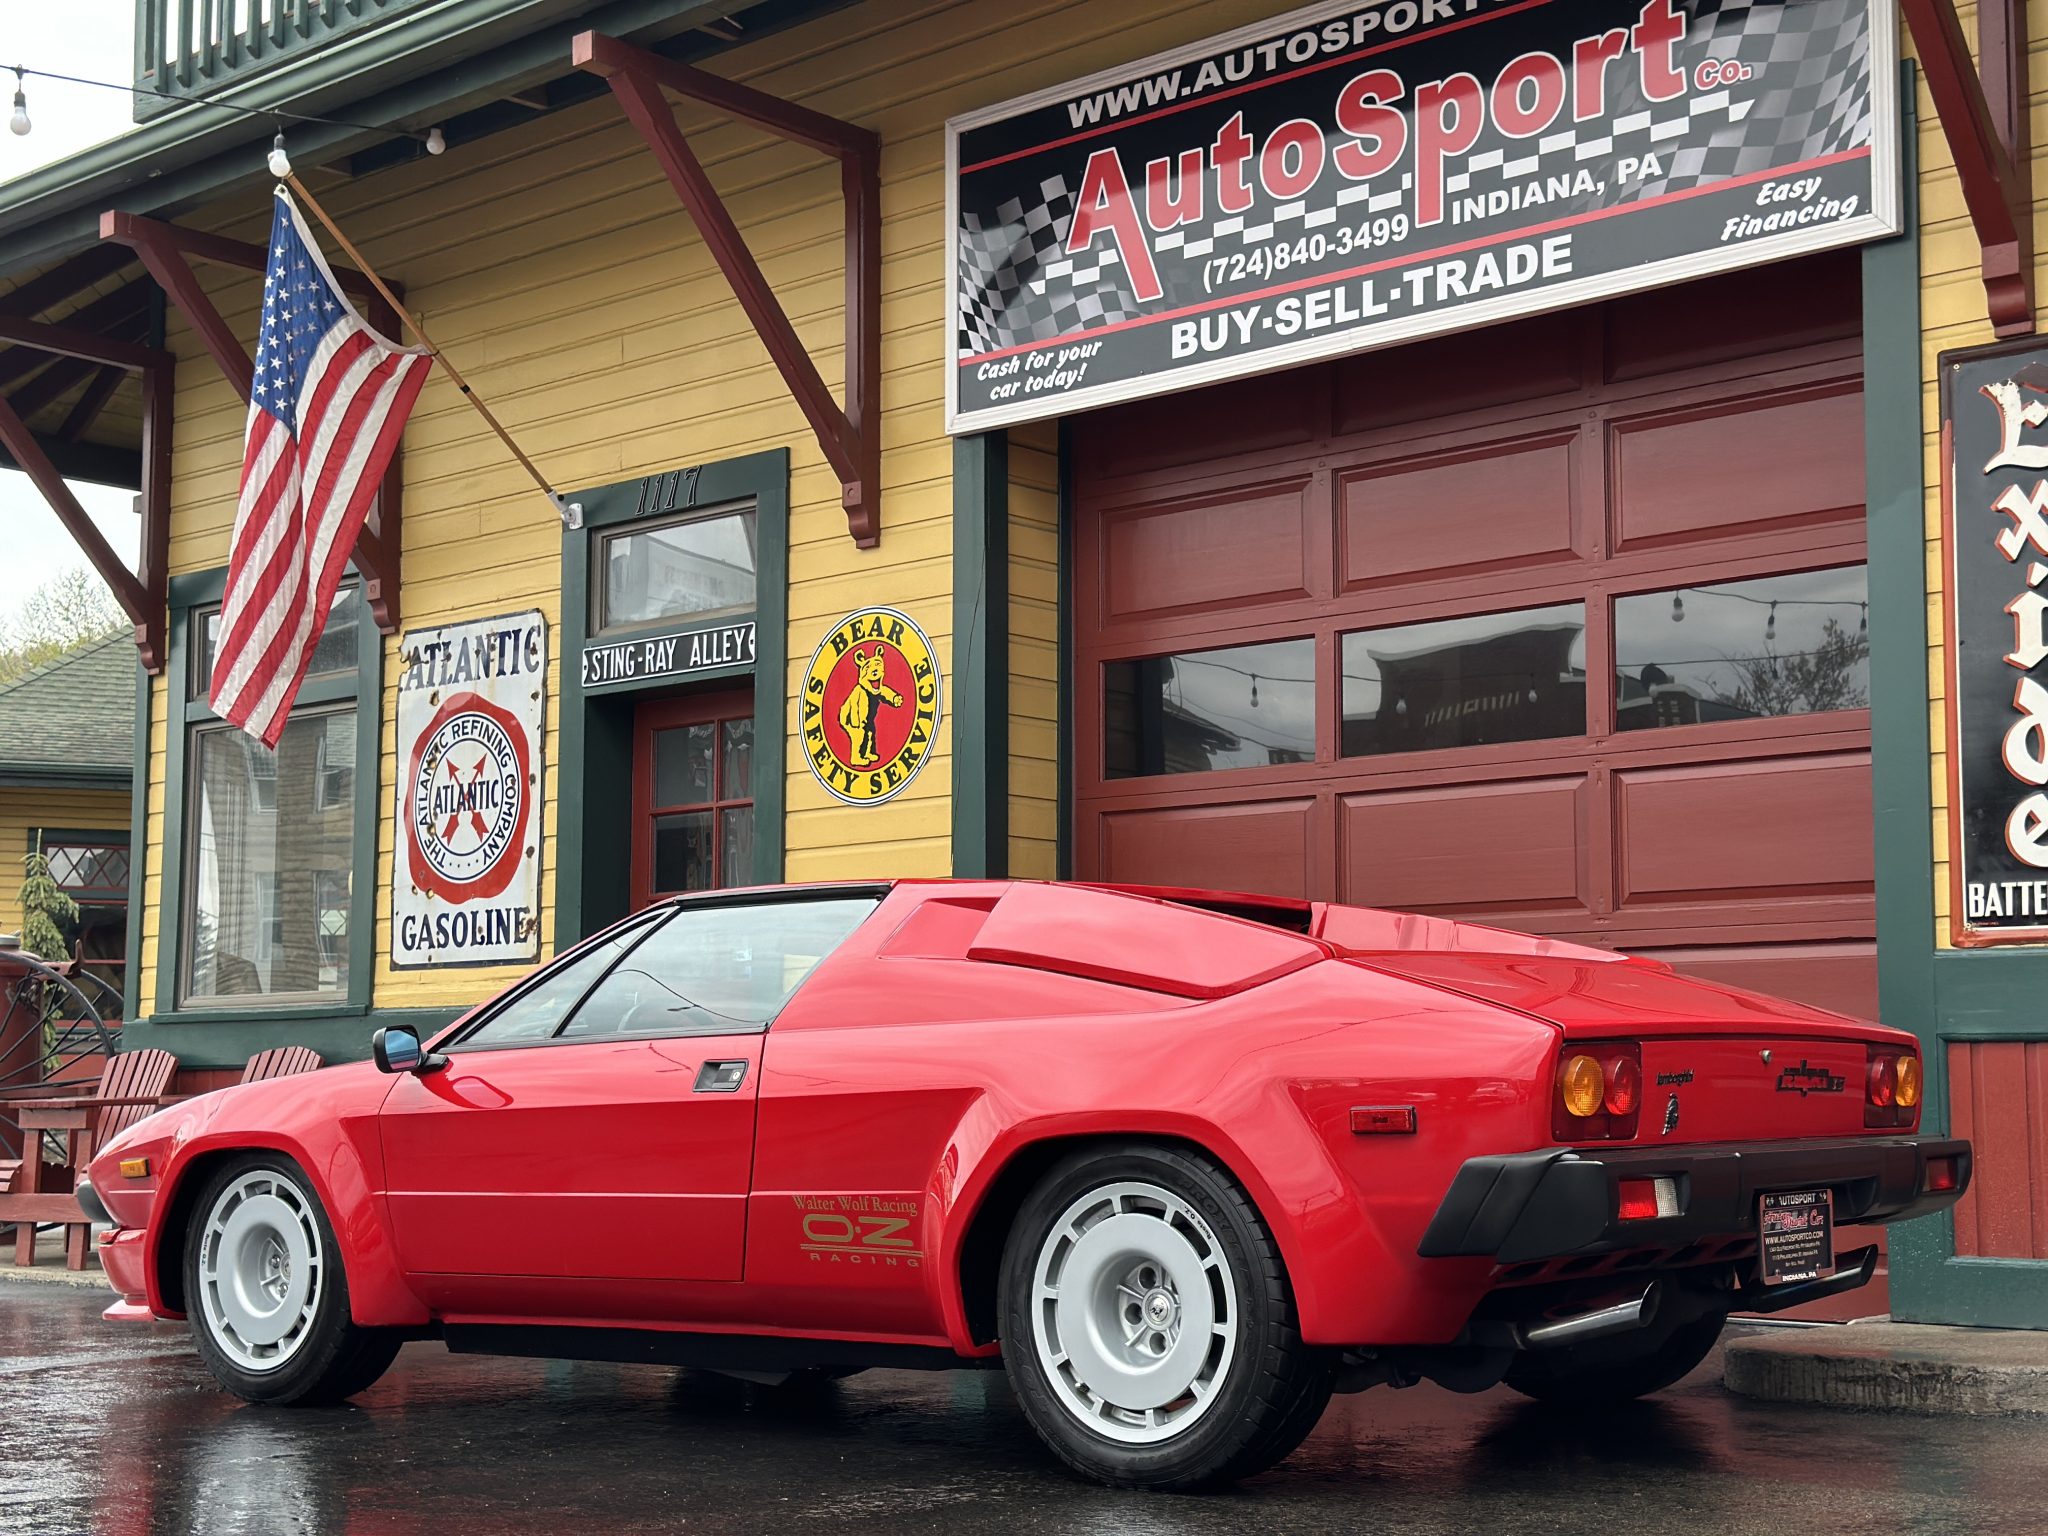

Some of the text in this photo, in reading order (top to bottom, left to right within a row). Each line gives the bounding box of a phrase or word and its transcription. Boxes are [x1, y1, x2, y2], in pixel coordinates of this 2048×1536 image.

[1068, 0, 1506, 129] WWW.AUTOSPOR
[1065, 0, 1752, 303] AutoSport Co.
[1452, 151, 1663, 225] INDIANA, PA
[1754, 175, 1822, 207] Easy
[1720, 193, 1860, 243] Financing
[1202, 213, 1410, 294] (724)840-3499
[977, 341, 1103, 381] Cash for your
[989, 362, 1088, 401] car today!
[635, 466, 702, 515] 1117
[404, 624, 541, 692] ATLANTIC
[591, 628, 747, 682] STING-RAY ALLEY
[830, 616, 905, 657] BEAR
[804, 656, 935, 795] SAFETY SERVICE
[423, 836, 446, 869] THE
[451, 719, 513, 768] REFINING
[483, 773, 518, 866] COMPANY
[433, 778, 500, 815] ATLANTIC
[401, 906, 531, 951] GASOLINE
[792, 1194, 918, 1217] Walter Wolf Racing
[1779, 1192, 1816, 1206] AUTOSPORT
[810, 1252, 920, 1267] RACING
